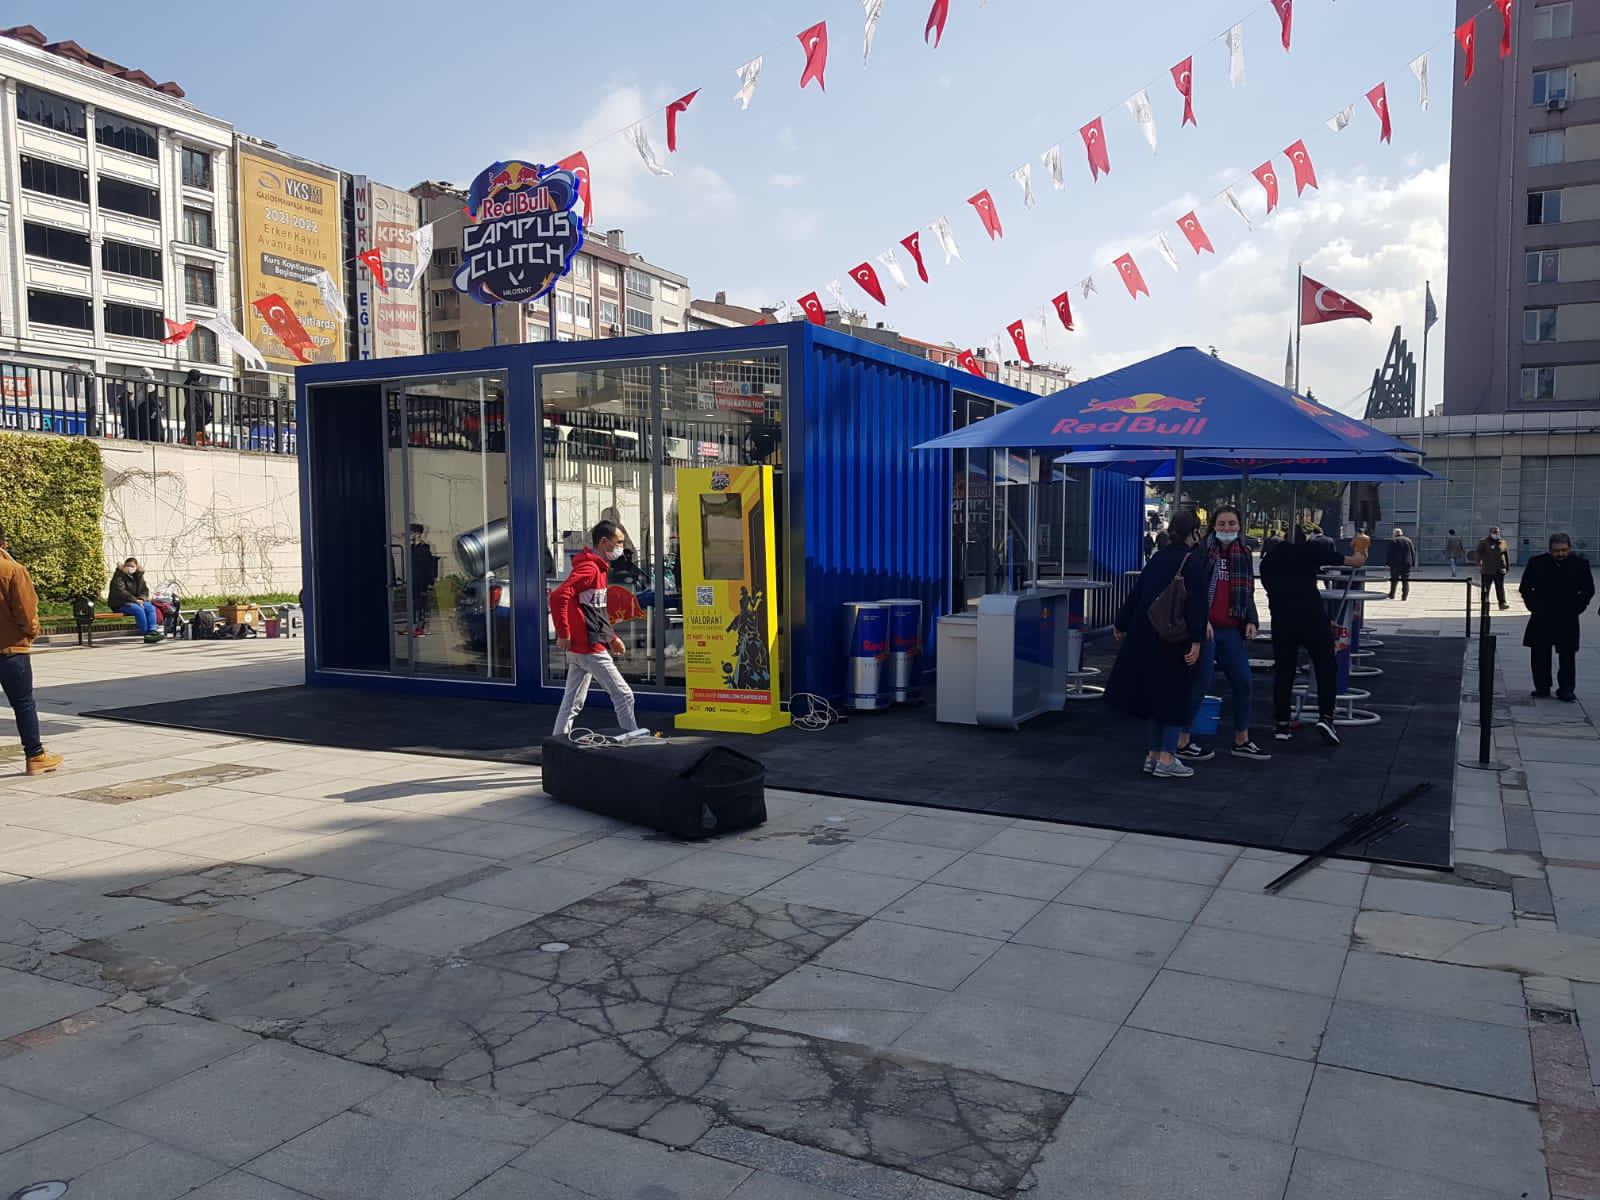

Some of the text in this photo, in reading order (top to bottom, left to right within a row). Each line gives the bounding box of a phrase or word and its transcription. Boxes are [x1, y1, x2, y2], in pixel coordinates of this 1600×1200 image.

[286, 178, 309, 200] YKS
[482, 186, 550, 220] Red Bull
[264, 223, 294, 239] Erken
[377, 225, 412, 244] KPSS
[463, 210, 570, 252] CAMPUS
[470, 242, 565, 280] CLUTCH
[1051, 416, 1208, 435] Red Bull
